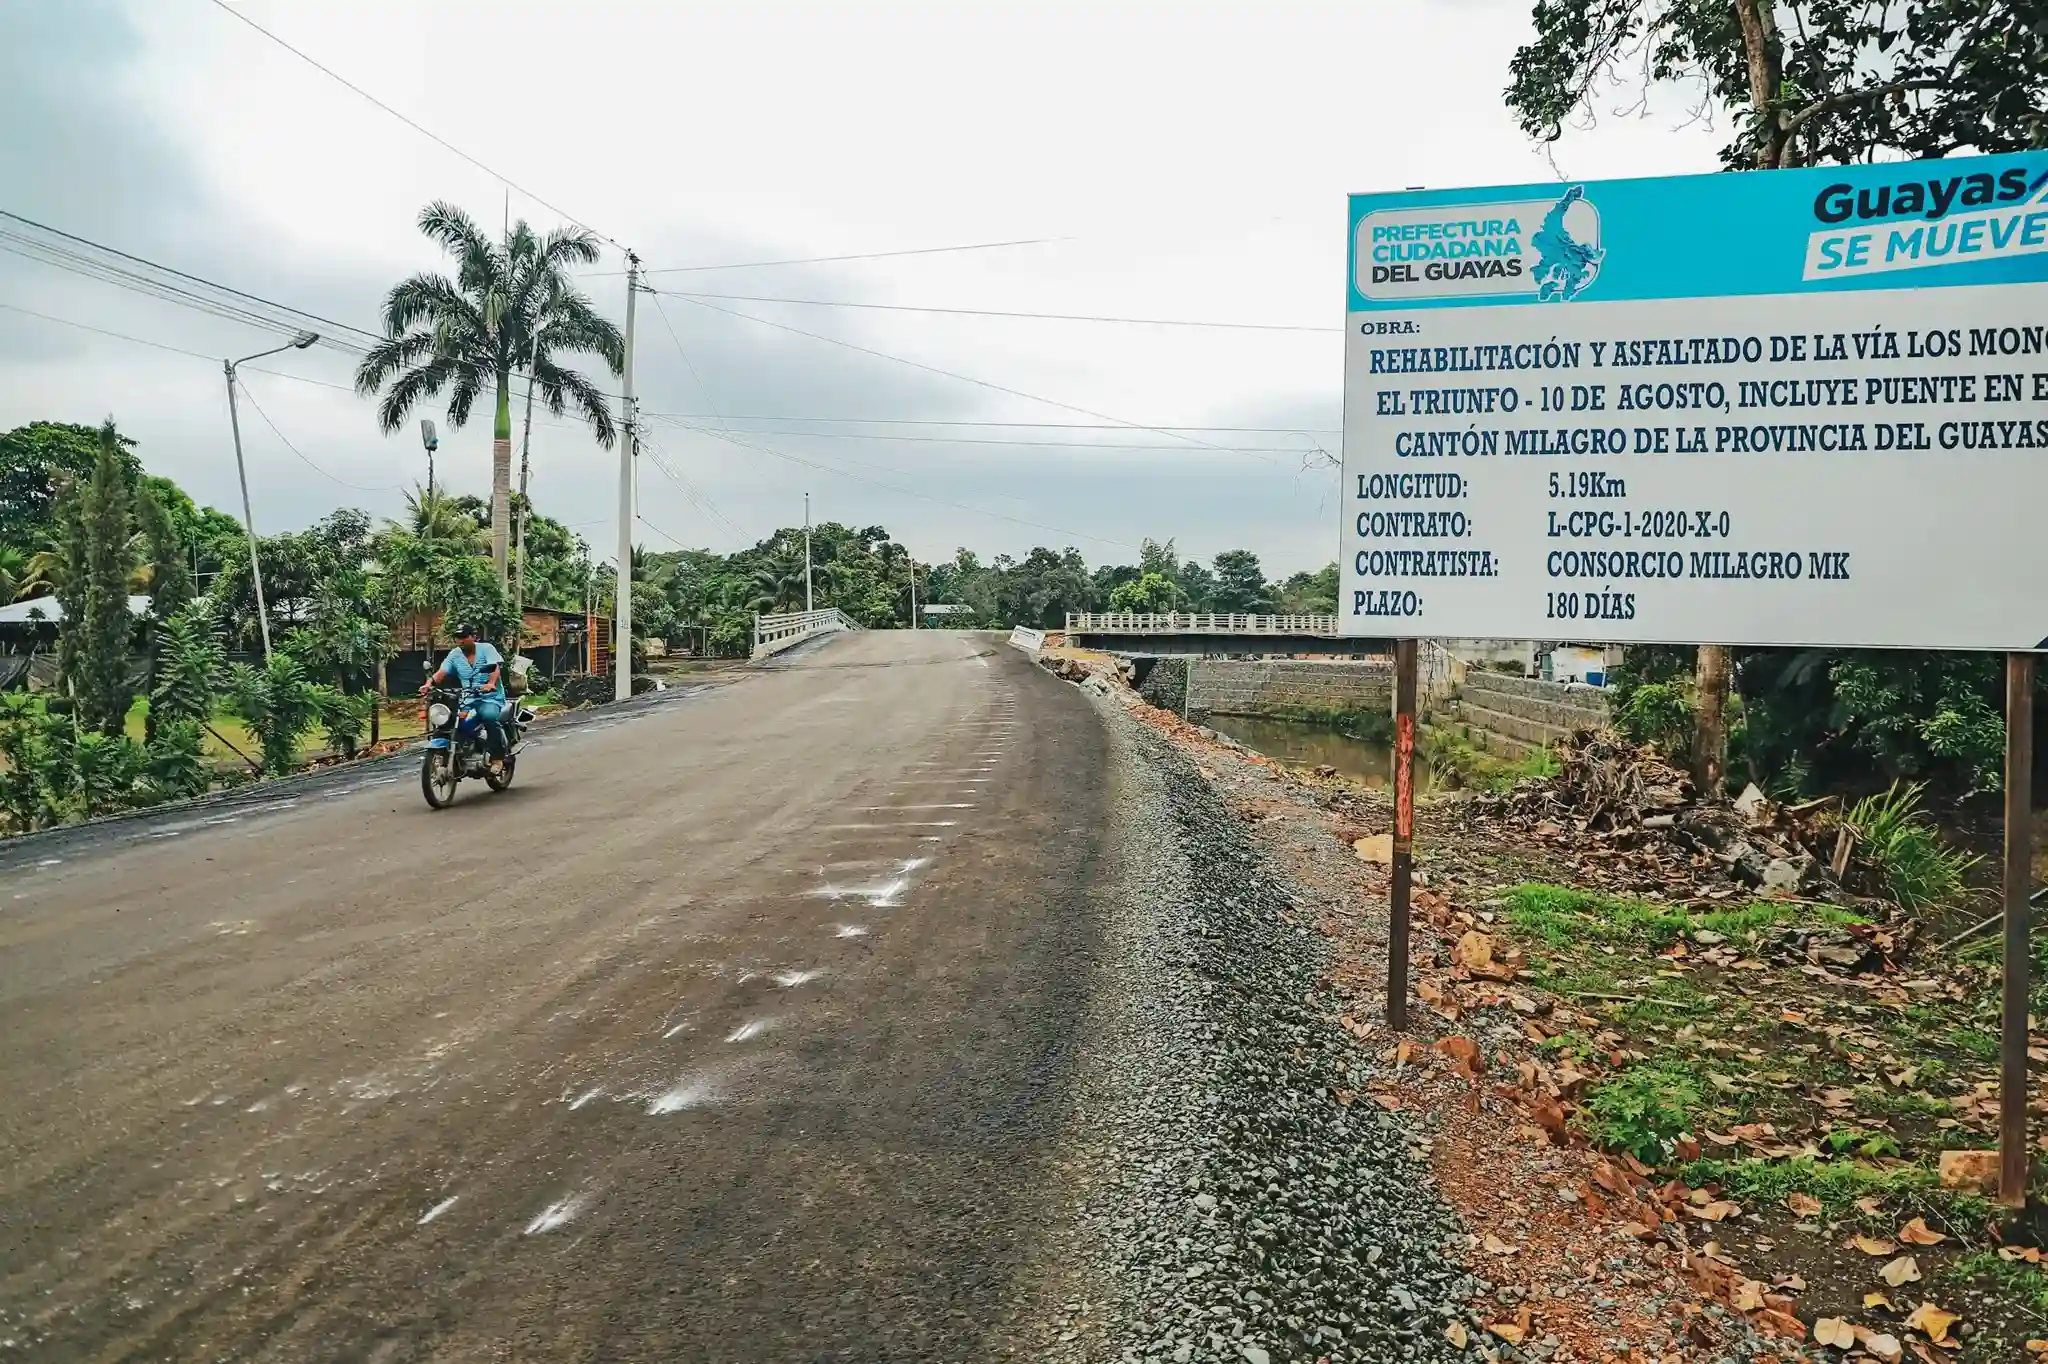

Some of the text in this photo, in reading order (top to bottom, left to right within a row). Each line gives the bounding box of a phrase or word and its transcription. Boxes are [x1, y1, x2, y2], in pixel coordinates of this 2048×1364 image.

[1815, 168, 2029, 224] Guayas
[1372, 218, 1521, 242] PREFECTURA
[1816, 211, 2048, 270] SE MUEVE
[1372, 238, 1522, 263] CIUDADANA
[1373, 259, 1522, 283] DEL GUAYAS
[1361, 321, 1420, 335] OBRA:
[1370, 324, 2048, 374] REHABILITACIÓN Y ASFALTADO DE LA VÍA LOS MON
[1377, 391, 1405, 415] EL
[1410, 388, 1518, 414] TRIUNFO
[1541, 386, 1564, 411] 10
[1571, 386, 1605, 411] DE
[1617, 382, 1729, 414] AGOSTO,
[1738, 379, 1857, 407] INCLUYE
[1865, 376, 1976, 404] PUENTE
[1984, 374, 2024, 402] EN
[1396, 424, 1499, 457] CANTÓN
[1505, 428, 1626, 455] MILAGRO
[1634, 428, 1668, 453] DE
[1676, 427, 1708, 453] LA
[1715, 424, 1867, 452] PROVINCIA
[1874, 423, 1930, 450] DEL
[1357, 472, 1626, 499] LONGITUD: 5.19Km
[1357, 511, 1729, 537] CONTRATO: L-CPG-1-2020-X-0
[1356, 551, 1850, 579] CONTRATISTA: CONSORCIO MILAGRO MK
[1354, 585, 1635, 619] PLAZO: 180 DÍAS
